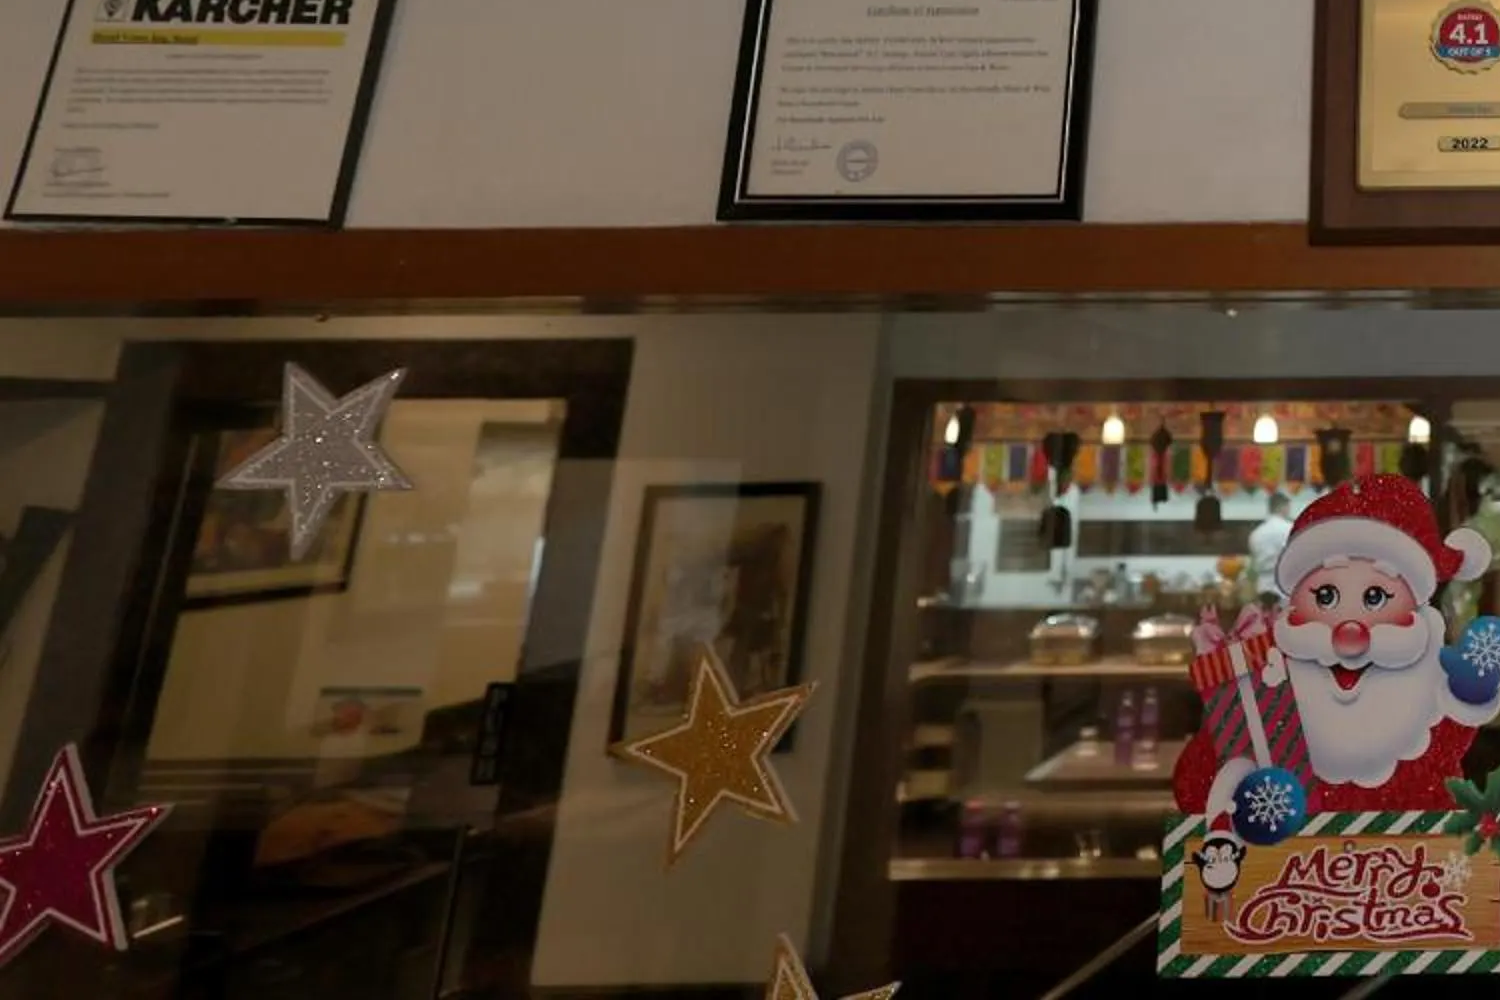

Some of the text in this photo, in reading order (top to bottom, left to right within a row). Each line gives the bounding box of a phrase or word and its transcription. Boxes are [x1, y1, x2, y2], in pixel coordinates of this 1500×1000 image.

[1449, 22, 1489, 45] 4.1
[1452, 136, 1488, 149] 2022
[1257, 845, 1444, 899] Merry
[1226, 888, 1473, 940] Christmas
